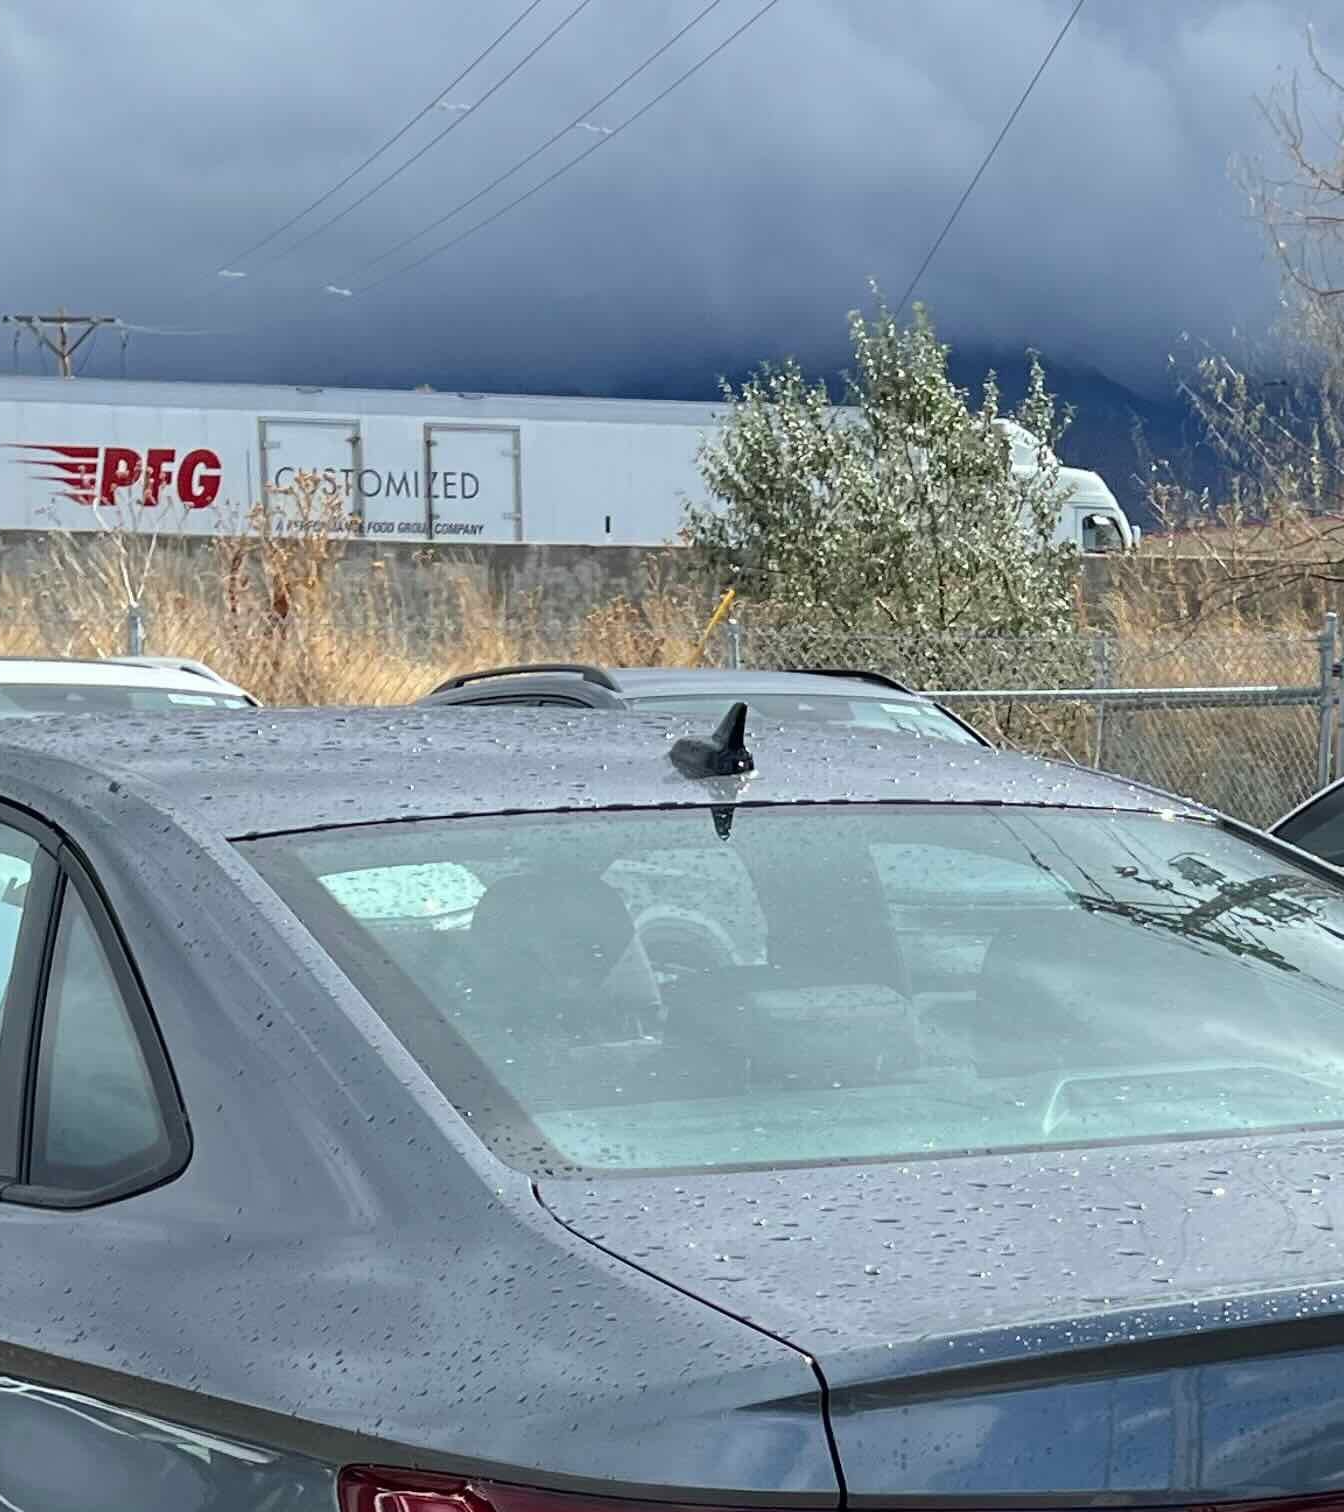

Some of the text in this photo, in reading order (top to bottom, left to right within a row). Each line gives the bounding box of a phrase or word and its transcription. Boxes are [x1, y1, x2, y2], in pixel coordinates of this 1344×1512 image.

[99, 446, 223, 509] PFG
[367, 520, 395, 534] FOOD
[433, 521, 485, 536] COMPANY
